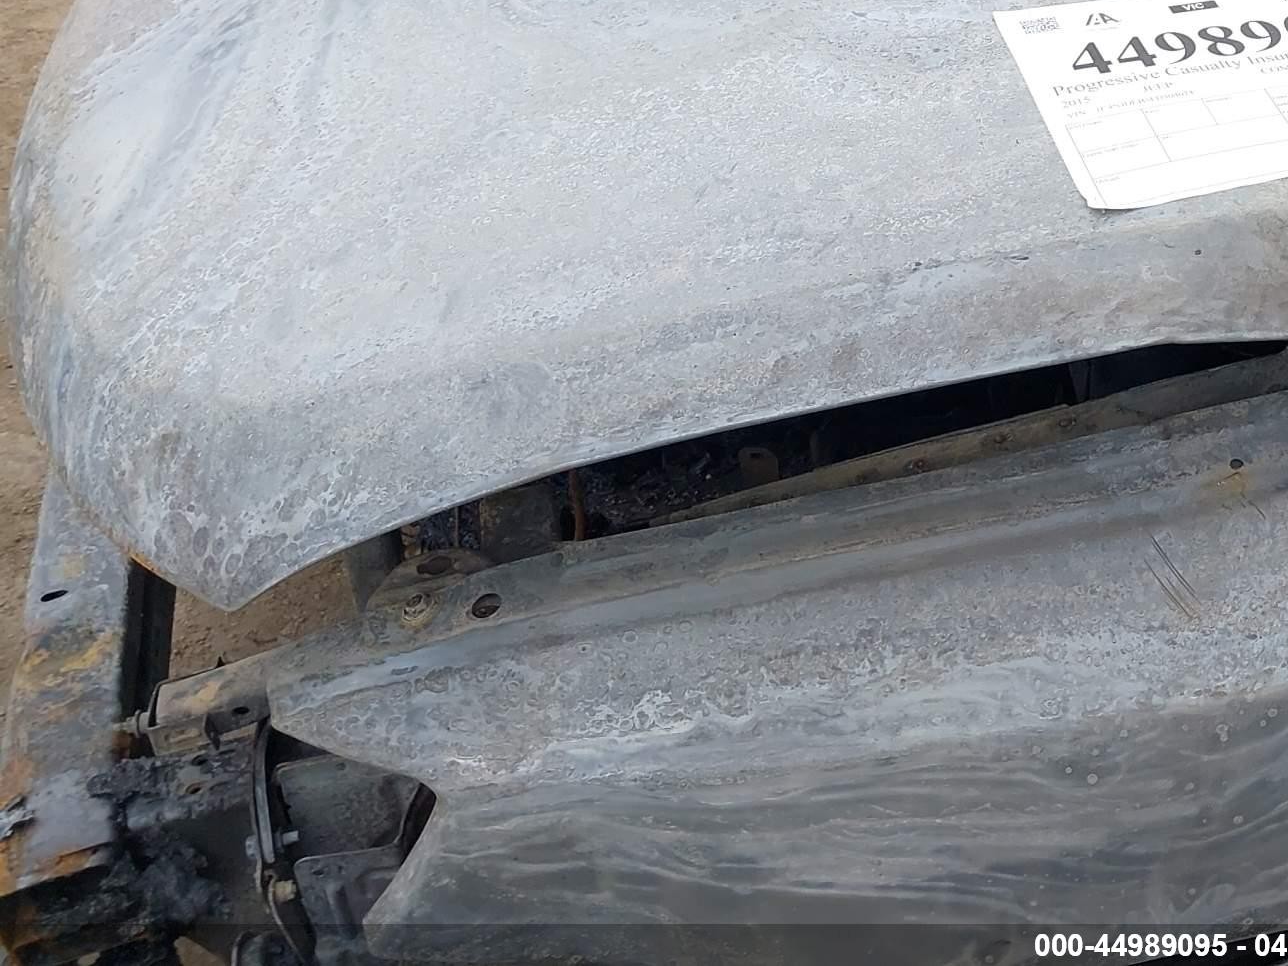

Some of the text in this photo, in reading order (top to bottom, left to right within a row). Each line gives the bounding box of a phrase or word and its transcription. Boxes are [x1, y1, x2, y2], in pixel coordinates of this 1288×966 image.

[1182, 1, 1205, 12] VIC
[1053, 70, 1161, 96] Progressive
[1165, 58, 1241, 76] Casualty
